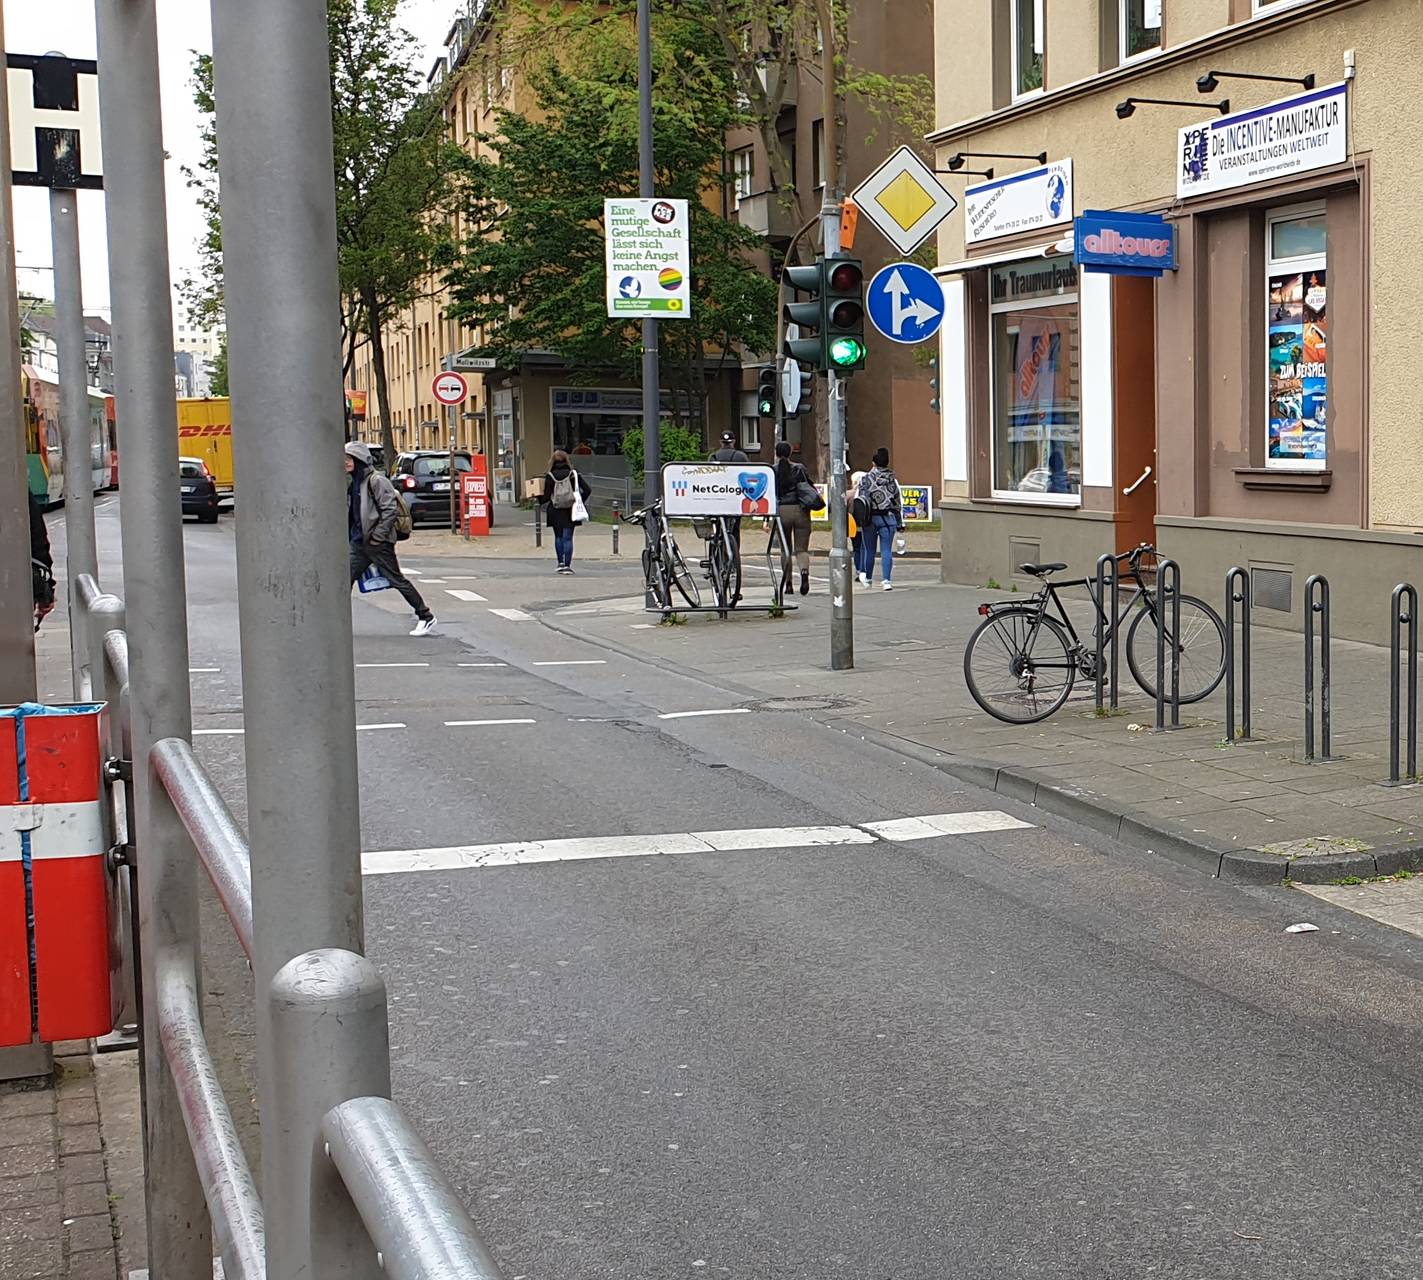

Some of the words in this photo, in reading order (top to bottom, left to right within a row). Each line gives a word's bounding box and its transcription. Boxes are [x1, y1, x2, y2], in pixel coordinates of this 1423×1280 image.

[6, 67, 103, 176] H
[1212, 133, 1225, 157] Die
[1226, 101, 1338, 154] INCENTIVE-MANUFAKTUR
[1219, 143, 1288, 171] VERANSTALTUNGEN
[1289, 132, 1329, 154] WELTWEIT
[611, 205, 636, 215] Eine
[611, 216, 650, 227] mutige
[611, 226, 682, 238] Gesellschaft
[612, 239, 637, 249] lässt
[639, 239, 663, 249] sich
[612, 250, 642, 260] keine
[644, 250, 679, 263] Angst
[613, 261, 660, 271] machen.
[993, 273, 1007, 298] Ihr
[1280, 363, 1295, 379] ZUM
[692, 484, 754, 496] NetCologne
[902, 490, 920, 498] UER
